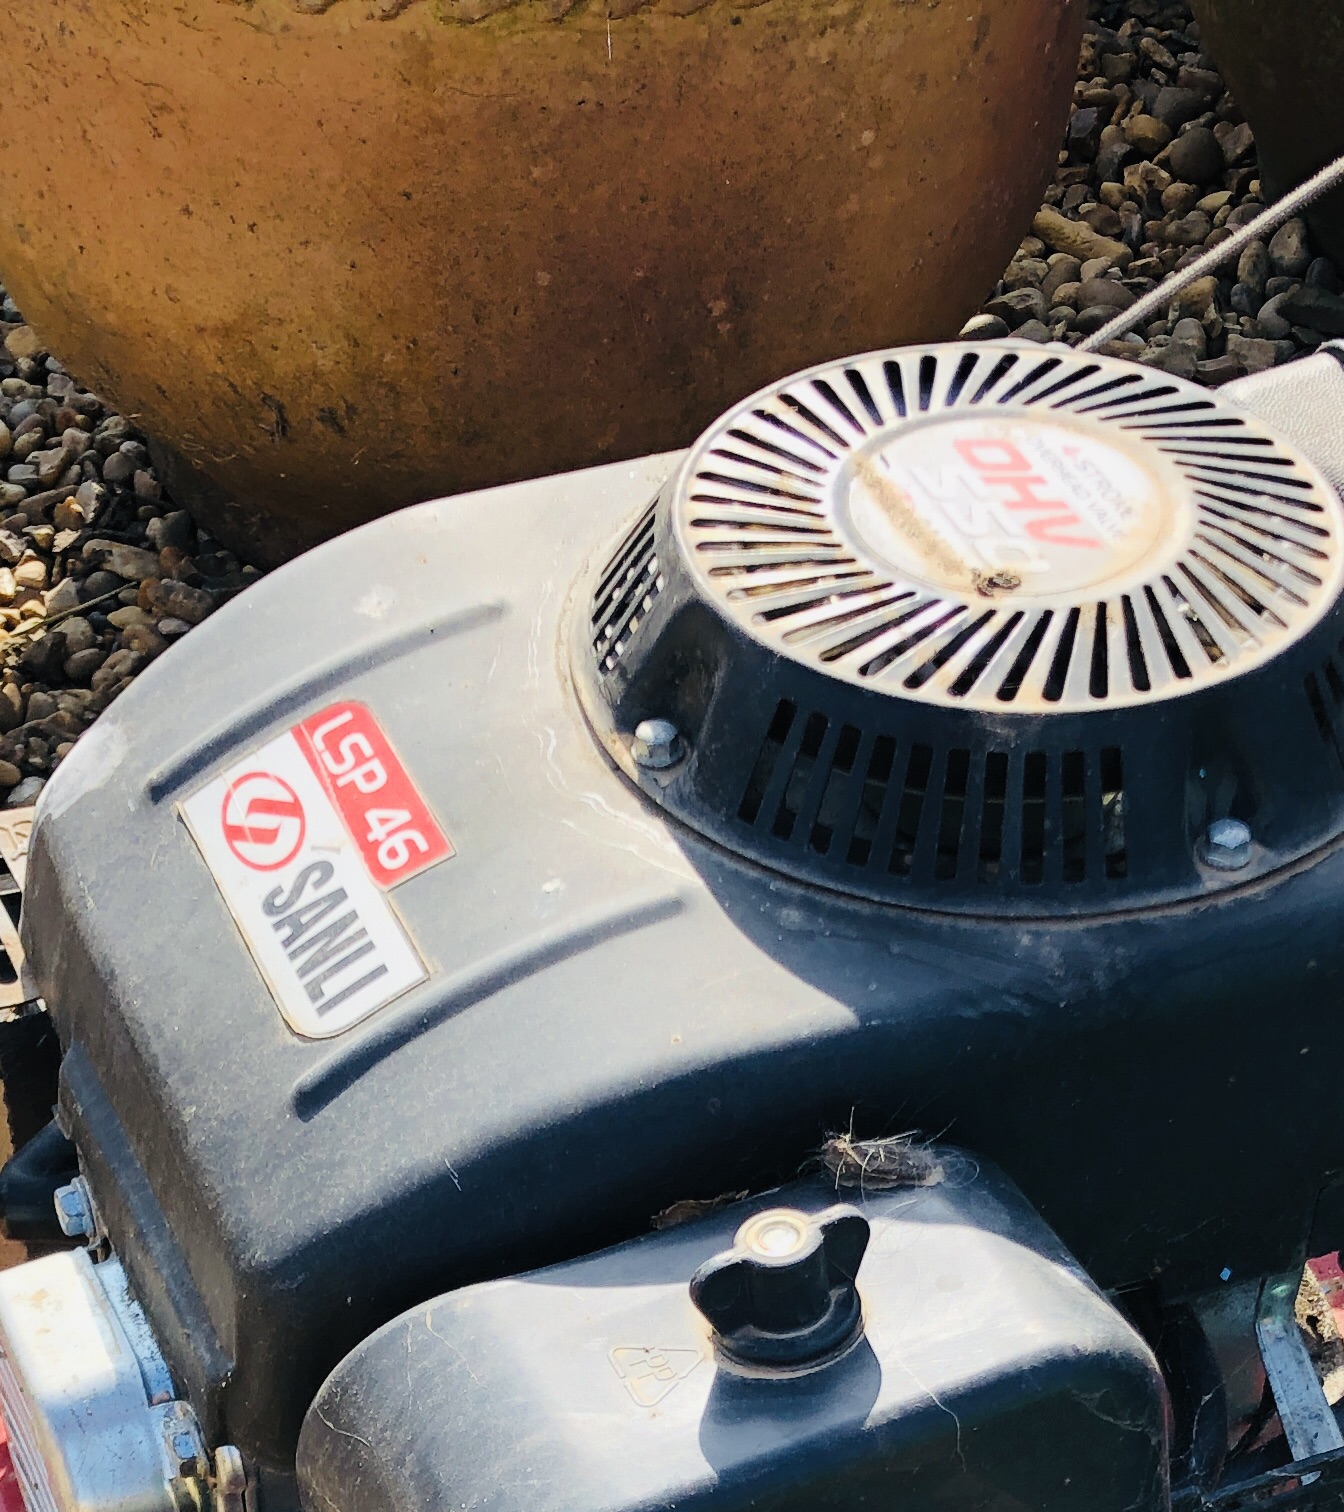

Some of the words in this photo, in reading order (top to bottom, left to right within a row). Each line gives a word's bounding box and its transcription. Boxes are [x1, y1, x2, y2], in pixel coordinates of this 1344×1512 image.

[952, 438, 1103, 549] OHV
[311, 709, 388, 795] LSP
[363, 807, 430, 871] 46
[261, 859, 389, 1019] SANLI
